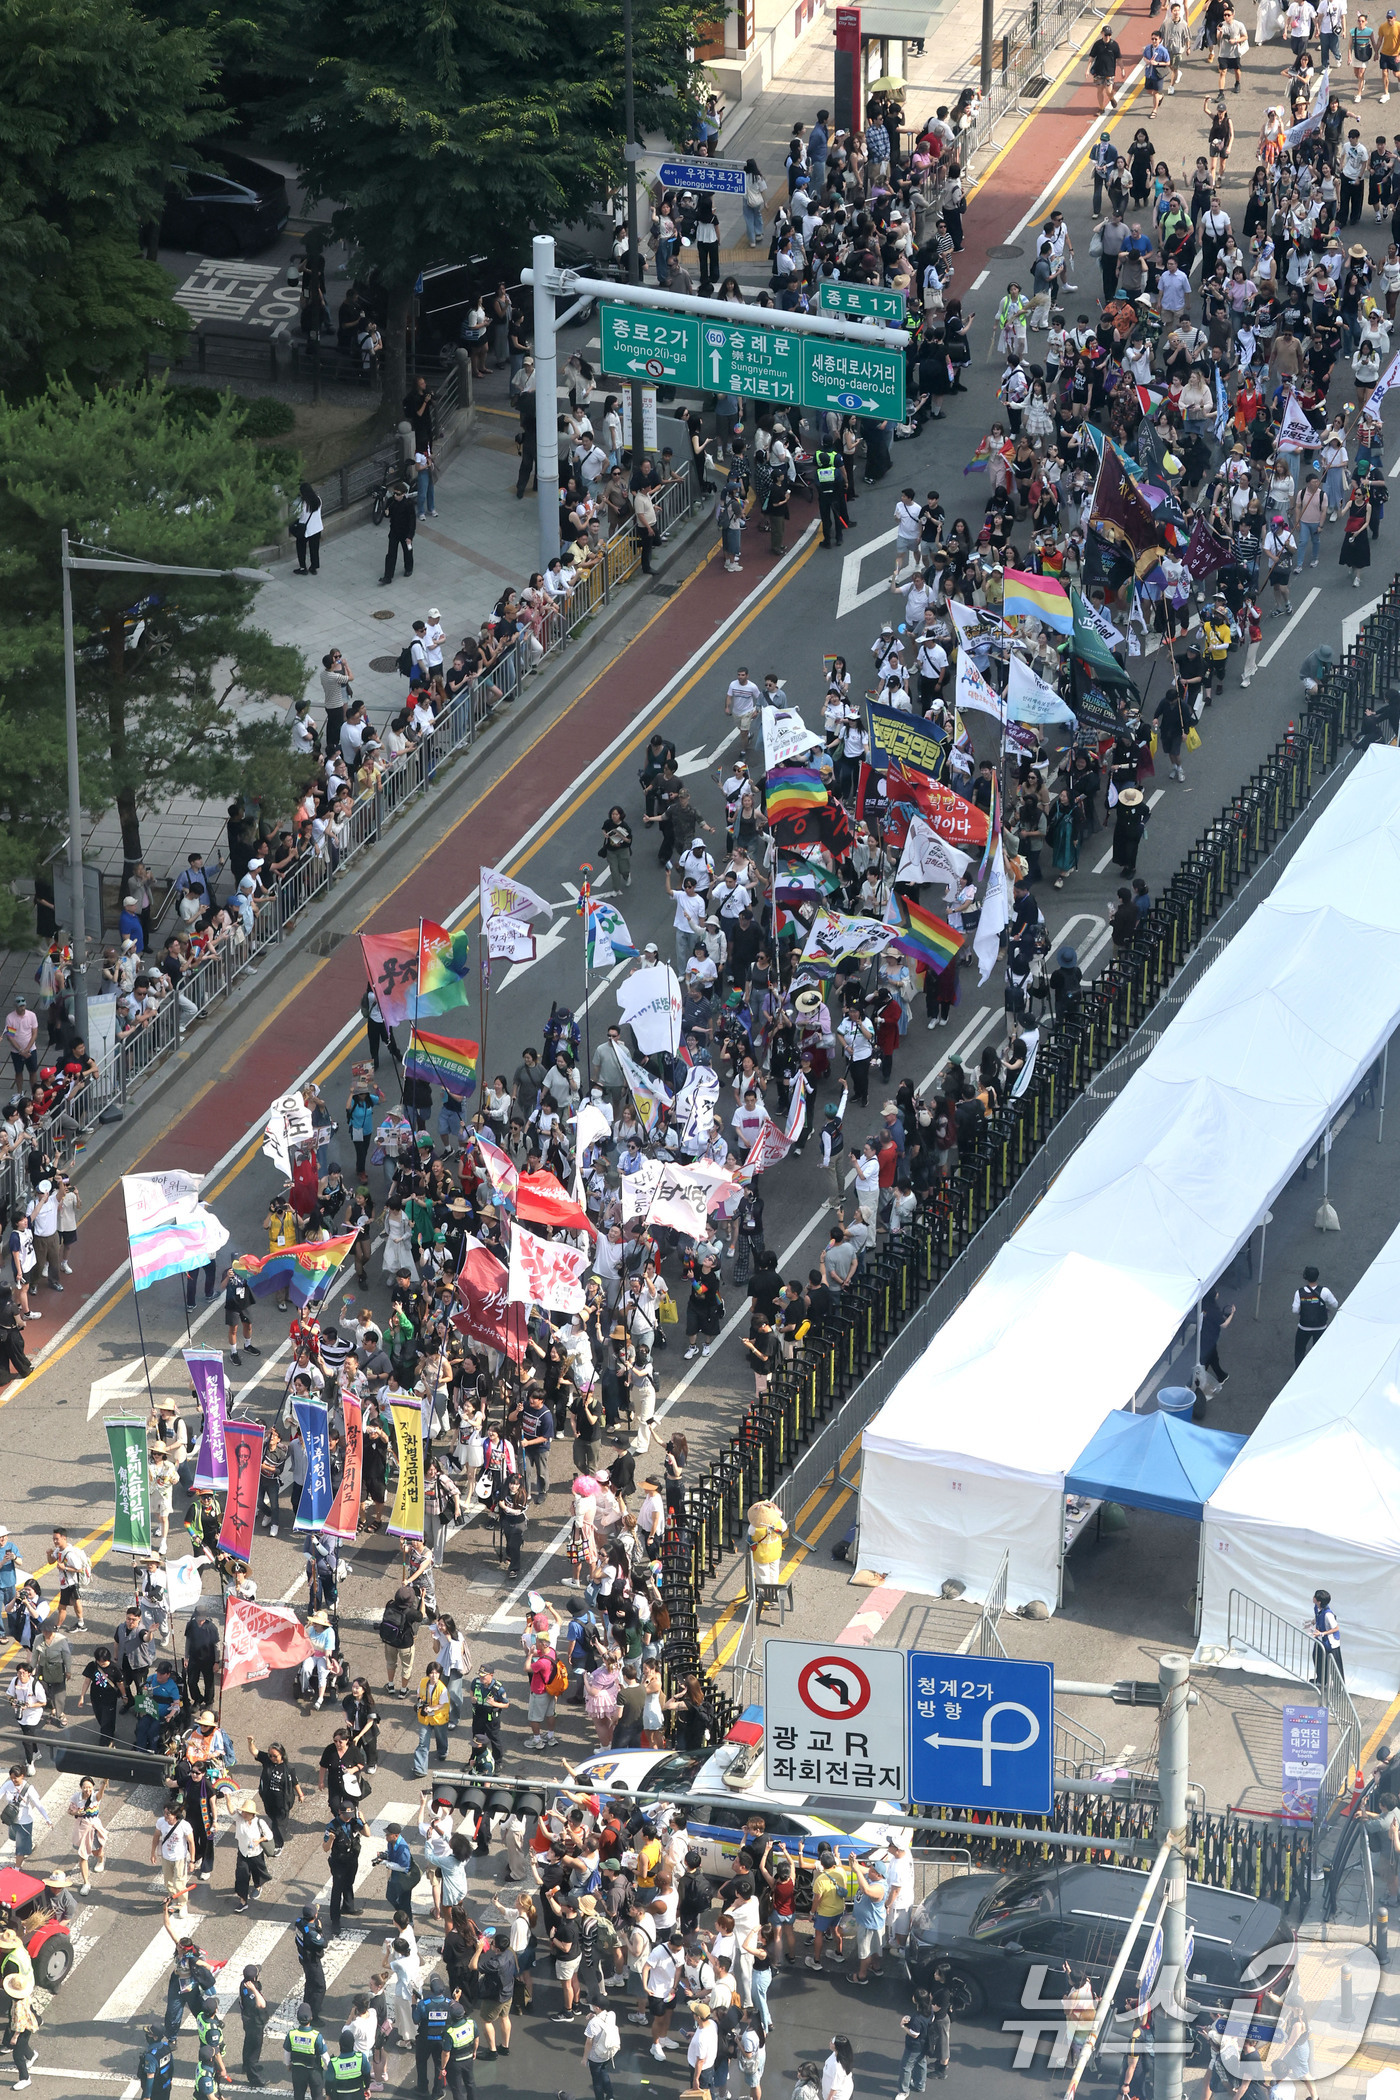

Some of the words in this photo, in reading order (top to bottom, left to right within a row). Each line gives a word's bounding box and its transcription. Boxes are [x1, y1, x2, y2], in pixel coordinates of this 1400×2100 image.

[674, 178, 725, 190] Ujeongguk-ro
[726, 184, 743, 192] 2-gil
[686, 168, 743, 184] 우정국로2길
[612, 319, 689, 348] 종로2가
[709, 333, 722, 343] 60
[728, 331, 791, 357] 숭례문
[613, 341, 652, 358] Jongno
[654, 347, 687, 363] 2(i)-ga
[731, 350, 772, 366] 崇礼门
[731, 361, 788, 378] Sungnyemun
[812, 353, 896, 383] 세종대로사거리
[728, 374, 795, 401] 을지로1가
[811, 371, 878, 392] Sejong-daero
[879, 383, 895, 395] Jct
[845, 395, 855, 407] 6
[1093, 618, 1115, 640] Fried
[443, 1060, 471, 1077] 네트워크
[312, 1433, 327, 1495] 기후정의
[406, 1434, 419, 1503] 차별금지법
[126, 1444, 146, 1528] 팔레스타인에
[917, 1677, 994, 1701] 청계2가
[917, 1700, 962, 1720] 방향
[772, 1726, 833, 1753] 광교
[845, 1731, 869, 1758] R
[1290, 1727, 1320, 1739] 출연진
[1290, 1738, 1320, 1749] 대기실
[773, 1757, 901, 1790] 좌회전금지
